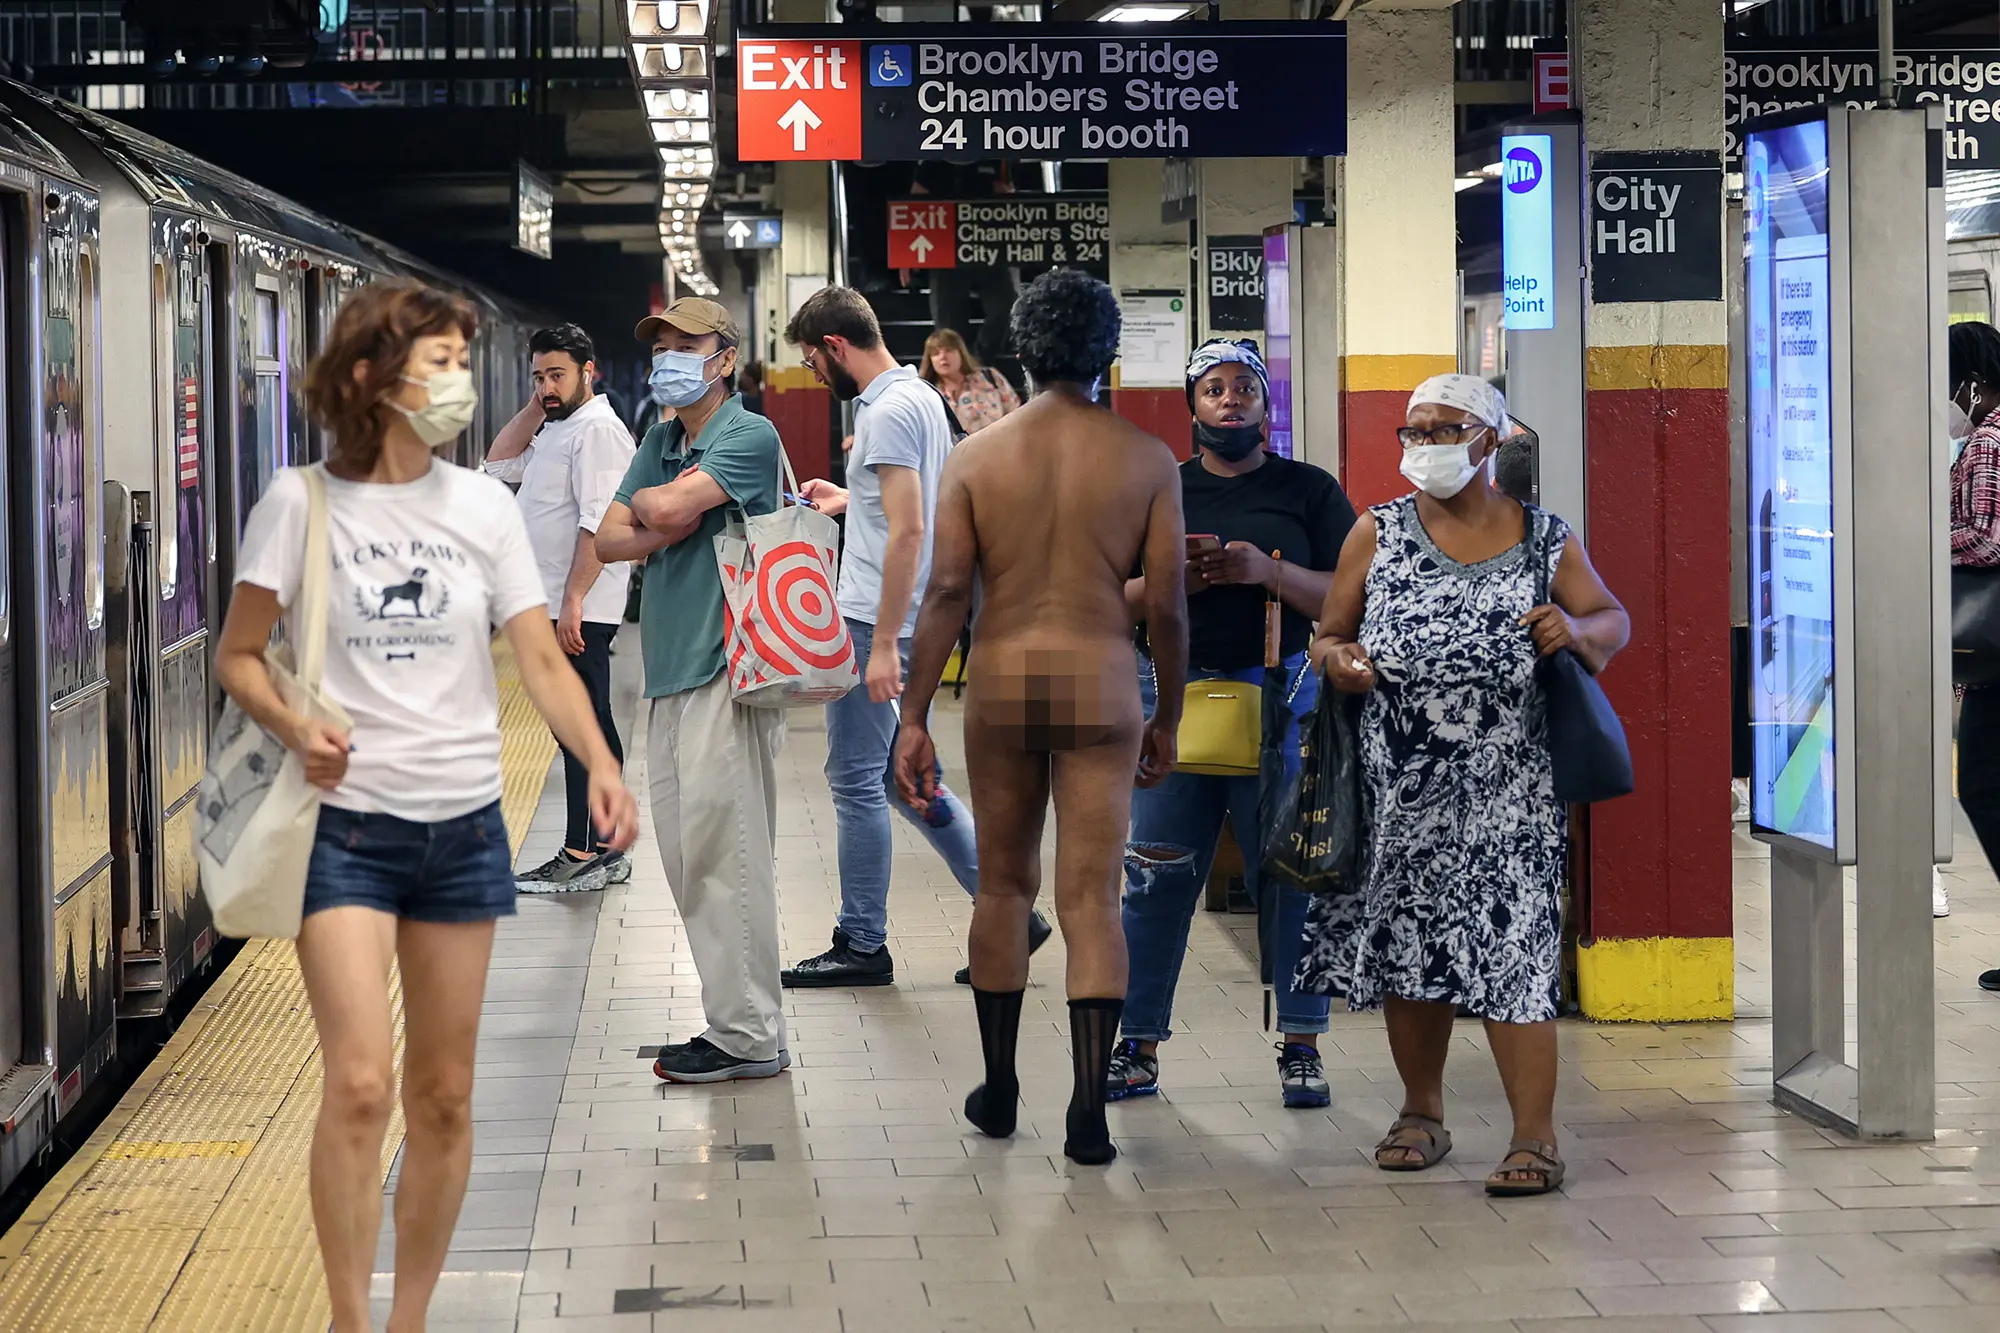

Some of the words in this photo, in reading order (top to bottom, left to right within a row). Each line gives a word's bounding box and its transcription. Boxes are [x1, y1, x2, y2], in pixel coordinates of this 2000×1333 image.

[742, 45, 847, 90] Exit
[919, 43, 1082, 81] Brooklyn
[1100, 42, 1218, 80] Bridge
[918, 80, 1107, 113] Chambers
[1125, 79, 1239, 111] Street
[920, 118, 967, 150] 24
[983, 118, 1065, 150] hour
[1082, 117, 1189, 149] booth
[1596, 176, 1682, 218] City
[890, 204, 947, 230] Exit
[957, 203, 1048, 224] Brooklyn
[957, 223, 1062, 242] Chambers
[1596, 218, 1676, 254] Hall
[957, 243, 999, 266] City
[1006, 244, 1044, 262] Hall
[1051, 243, 1067, 262] &
[1076, 243, 1103, 262] 24
[1505, 274, 1538, 294] Help
[1505, 297, 1545, 313] Point
[346, 636, 373, 648] PET
